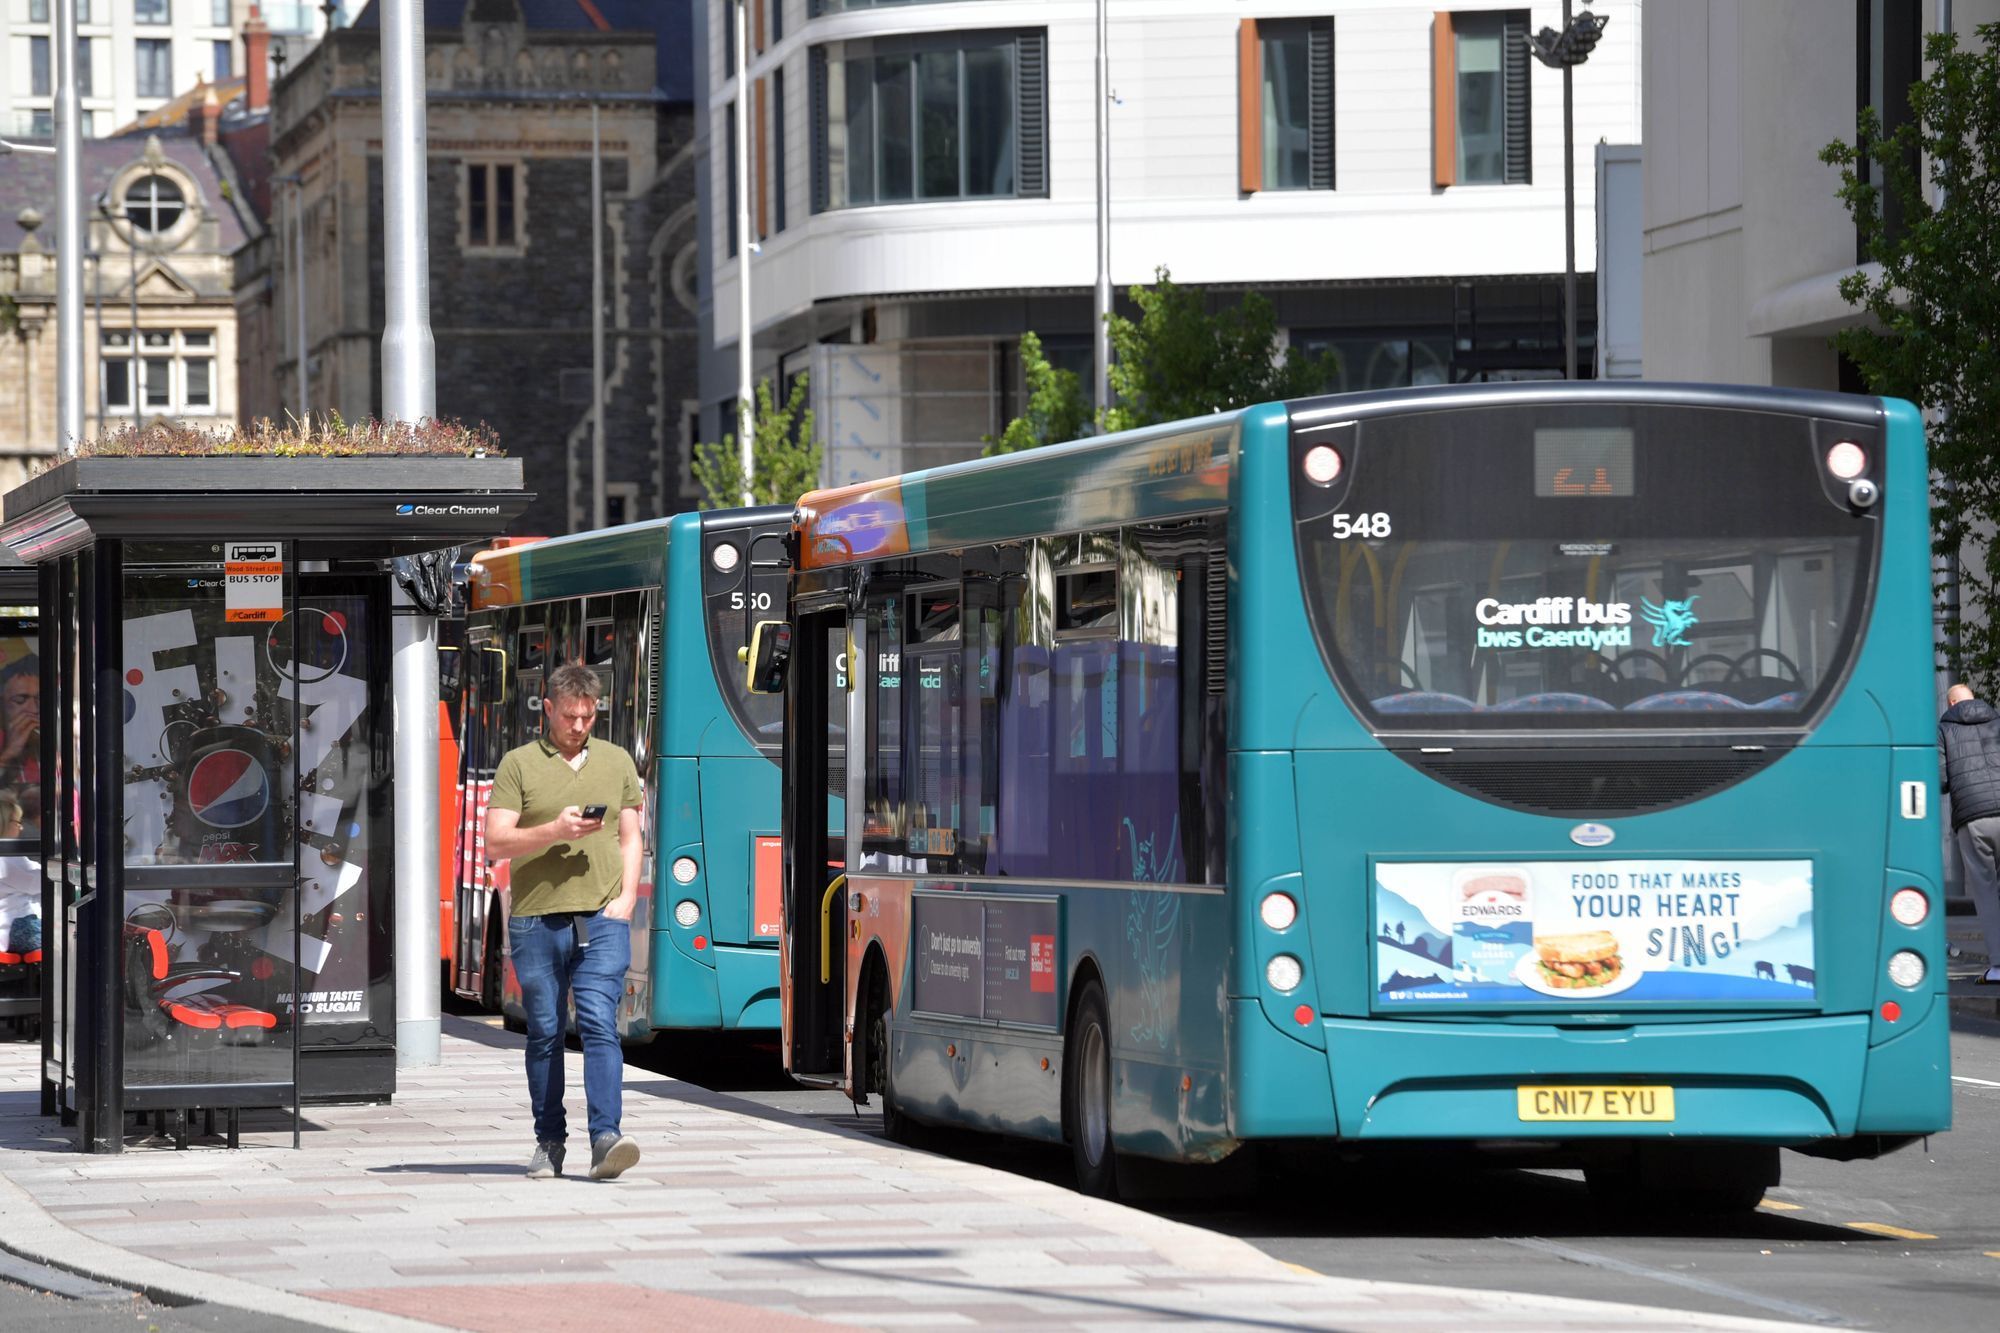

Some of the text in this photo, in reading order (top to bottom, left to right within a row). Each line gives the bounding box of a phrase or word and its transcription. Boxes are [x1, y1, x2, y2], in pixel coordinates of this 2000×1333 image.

[415, 505, 500, 515] Clear Channel
[1332, 512, 1392, 539] 548
[229, 575, 280, 583] BUS STOP
[238, 611, 266, 619] Cardiff
[1475, 597, 1632, 625] Cardiff bus
[1477, 626, 1632, 650] bws Caerdydd
[203, 832, 230, 843] pepsi
[198, 842, 259, 864] MAX
[1572, 872, 1742, 889] FOOD THAT MAKES
[1462, 905, 1522, 916] EDWARDS
[1573, 893, 1740, 918] YOUR HEART
[1646, 922, 1742, 967] SING!
[276, 990, 364, 1003] MAMUM TASTE
[315, 1002, 362, 1013] SUGAR
[1535, 1090, 1655, 1115] CN17 EYU
